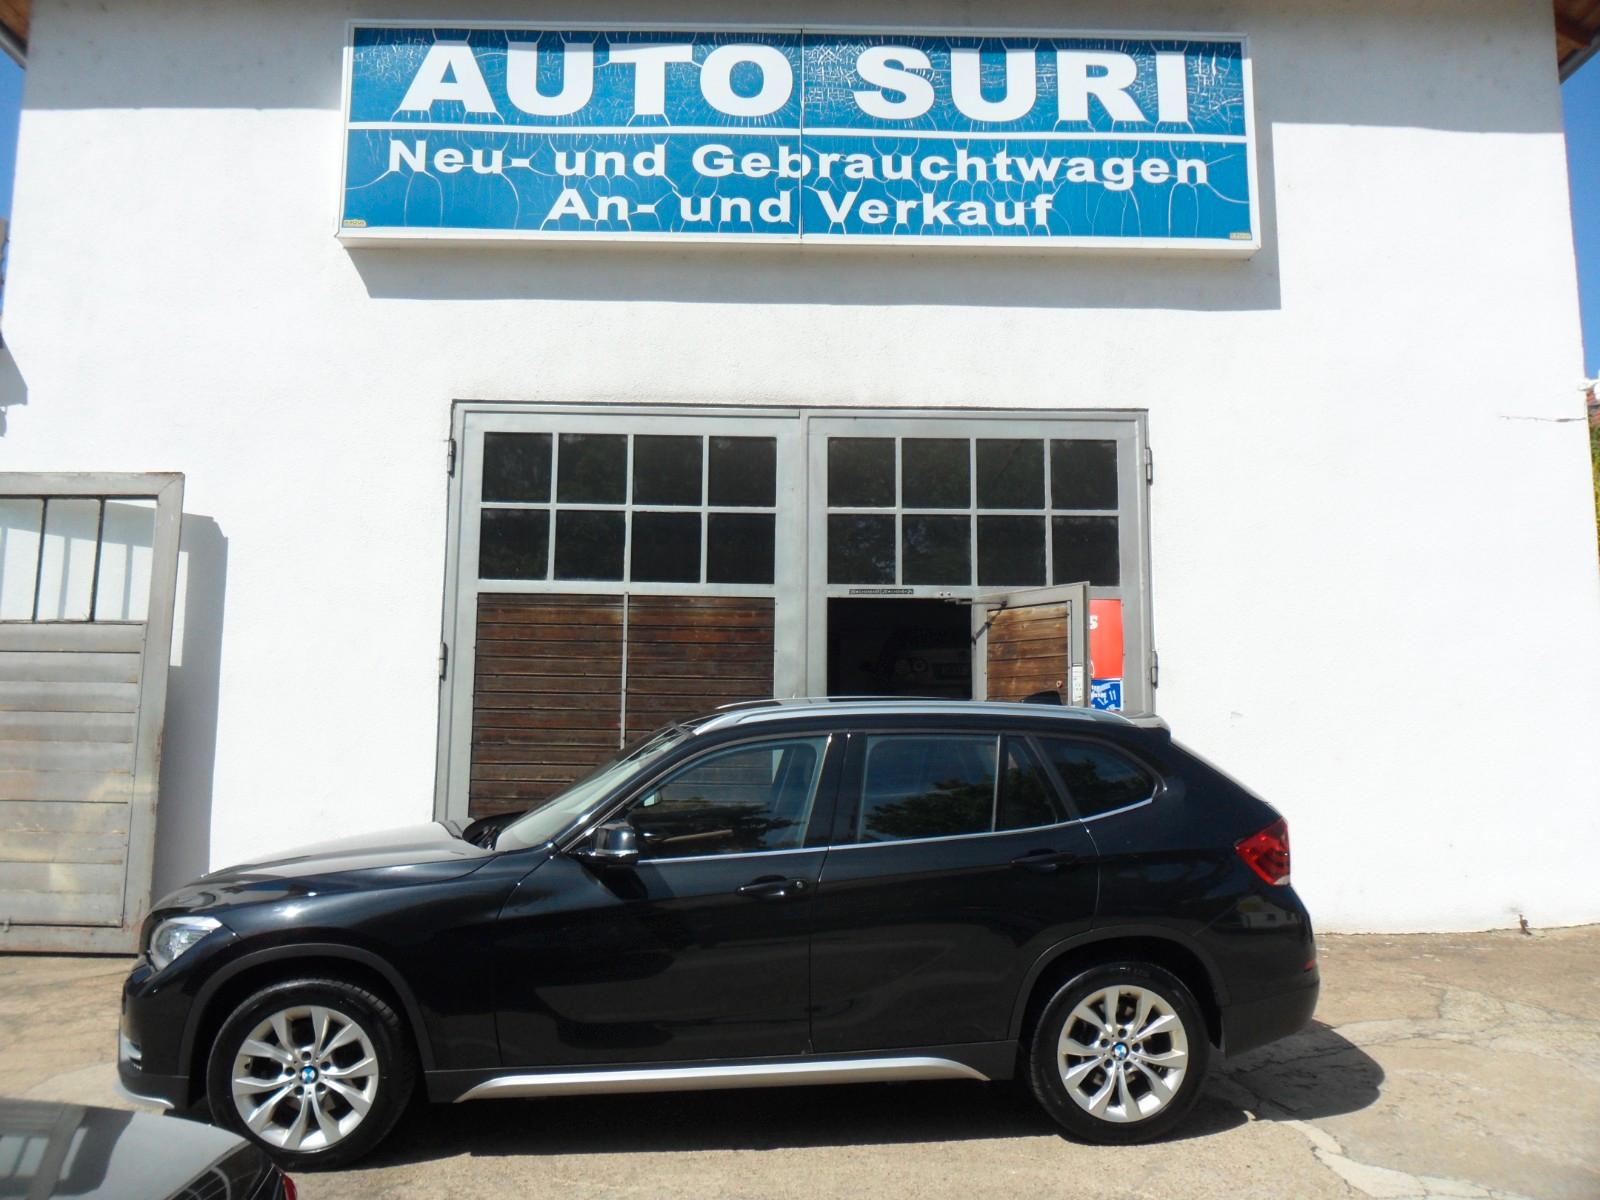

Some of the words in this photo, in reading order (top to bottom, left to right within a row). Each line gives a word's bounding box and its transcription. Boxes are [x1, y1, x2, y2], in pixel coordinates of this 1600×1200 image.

[398, 40, 794, 117] AUTO
[853, 46, 1189, 123] SURI
[388, 140, 531, 175] Neu-
[554, 144, 667, 177] und
[692, 144, 1208, 191] Gebrauchtwagen
[546, 189, 656, 221] An-
[680, 191, 792, 223] und
[818, 191, 1053, 226] Verkauf
